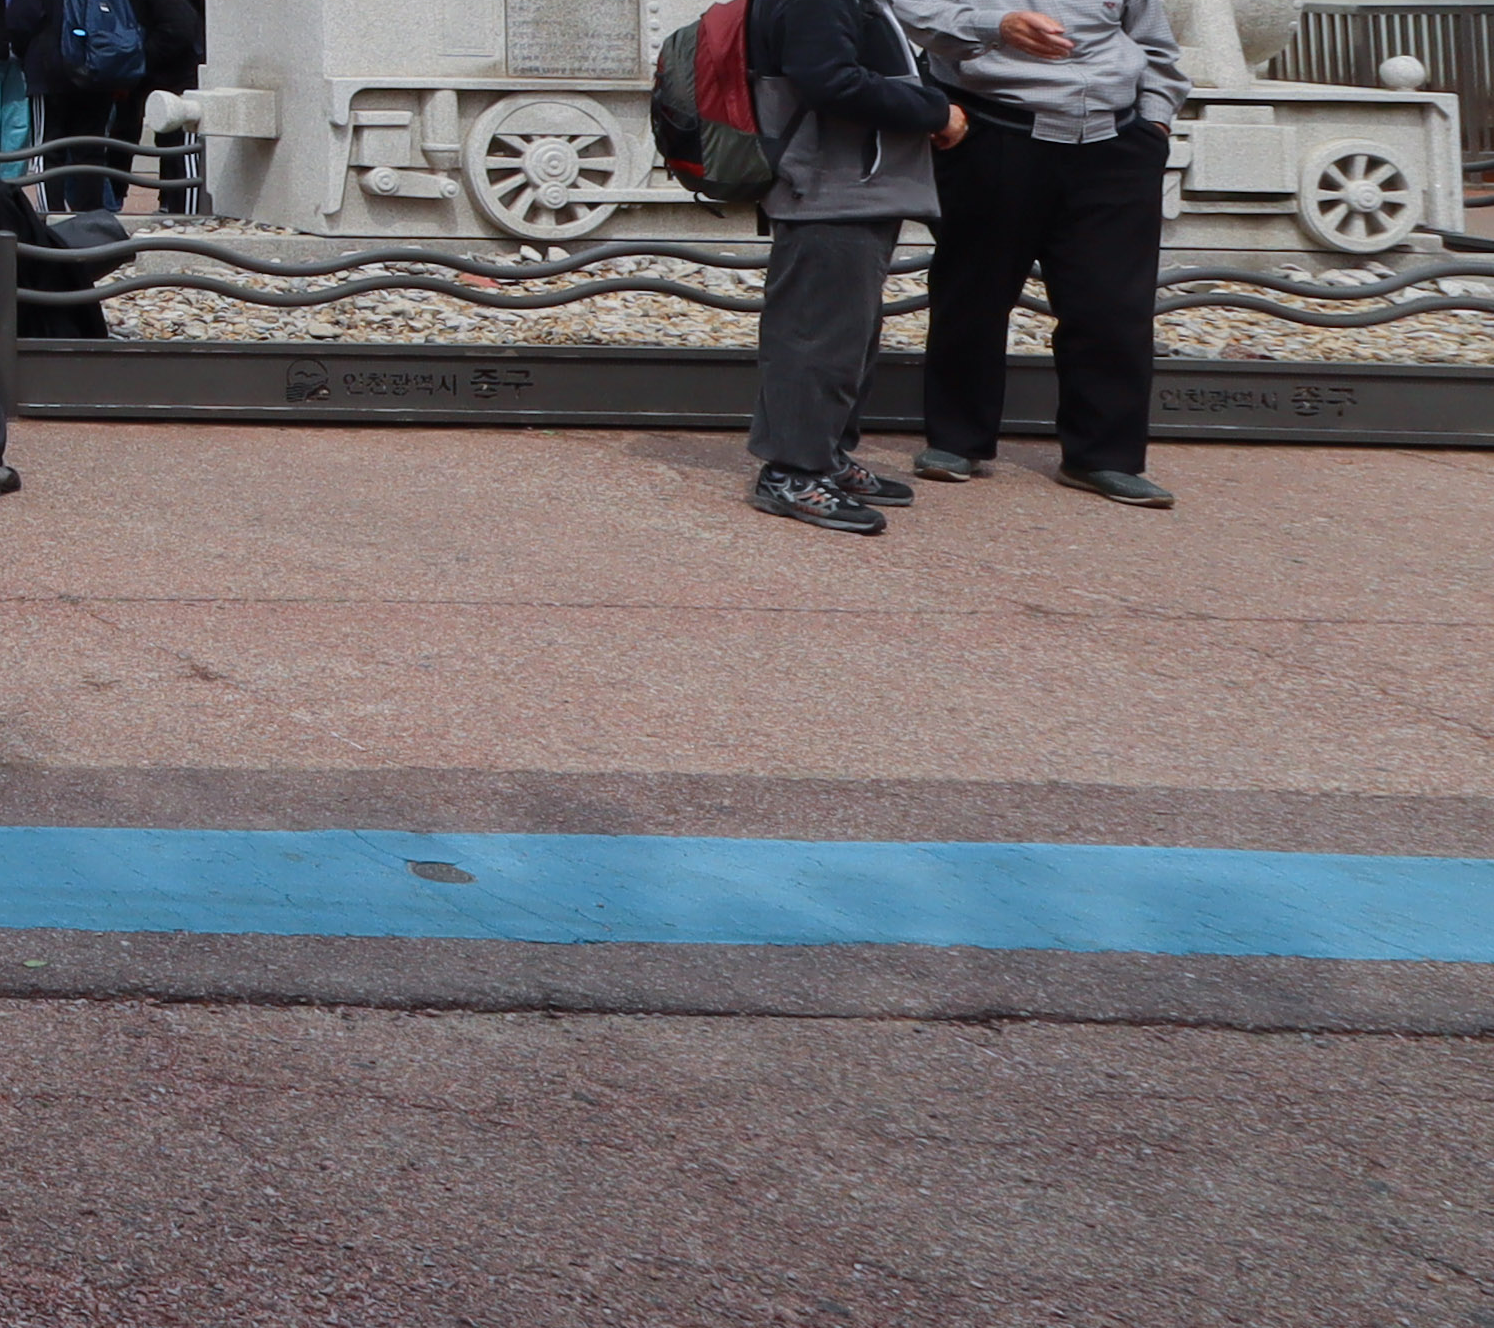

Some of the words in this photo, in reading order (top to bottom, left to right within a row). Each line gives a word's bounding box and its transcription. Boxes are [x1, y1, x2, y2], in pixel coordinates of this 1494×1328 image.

[342, 372, 458, 397] 인천광역시
[470, 368, 535, 400] 중구
[1159, 388, 1279, 413] 인천광역시
[1290, 385, 1358, 418] 중구
